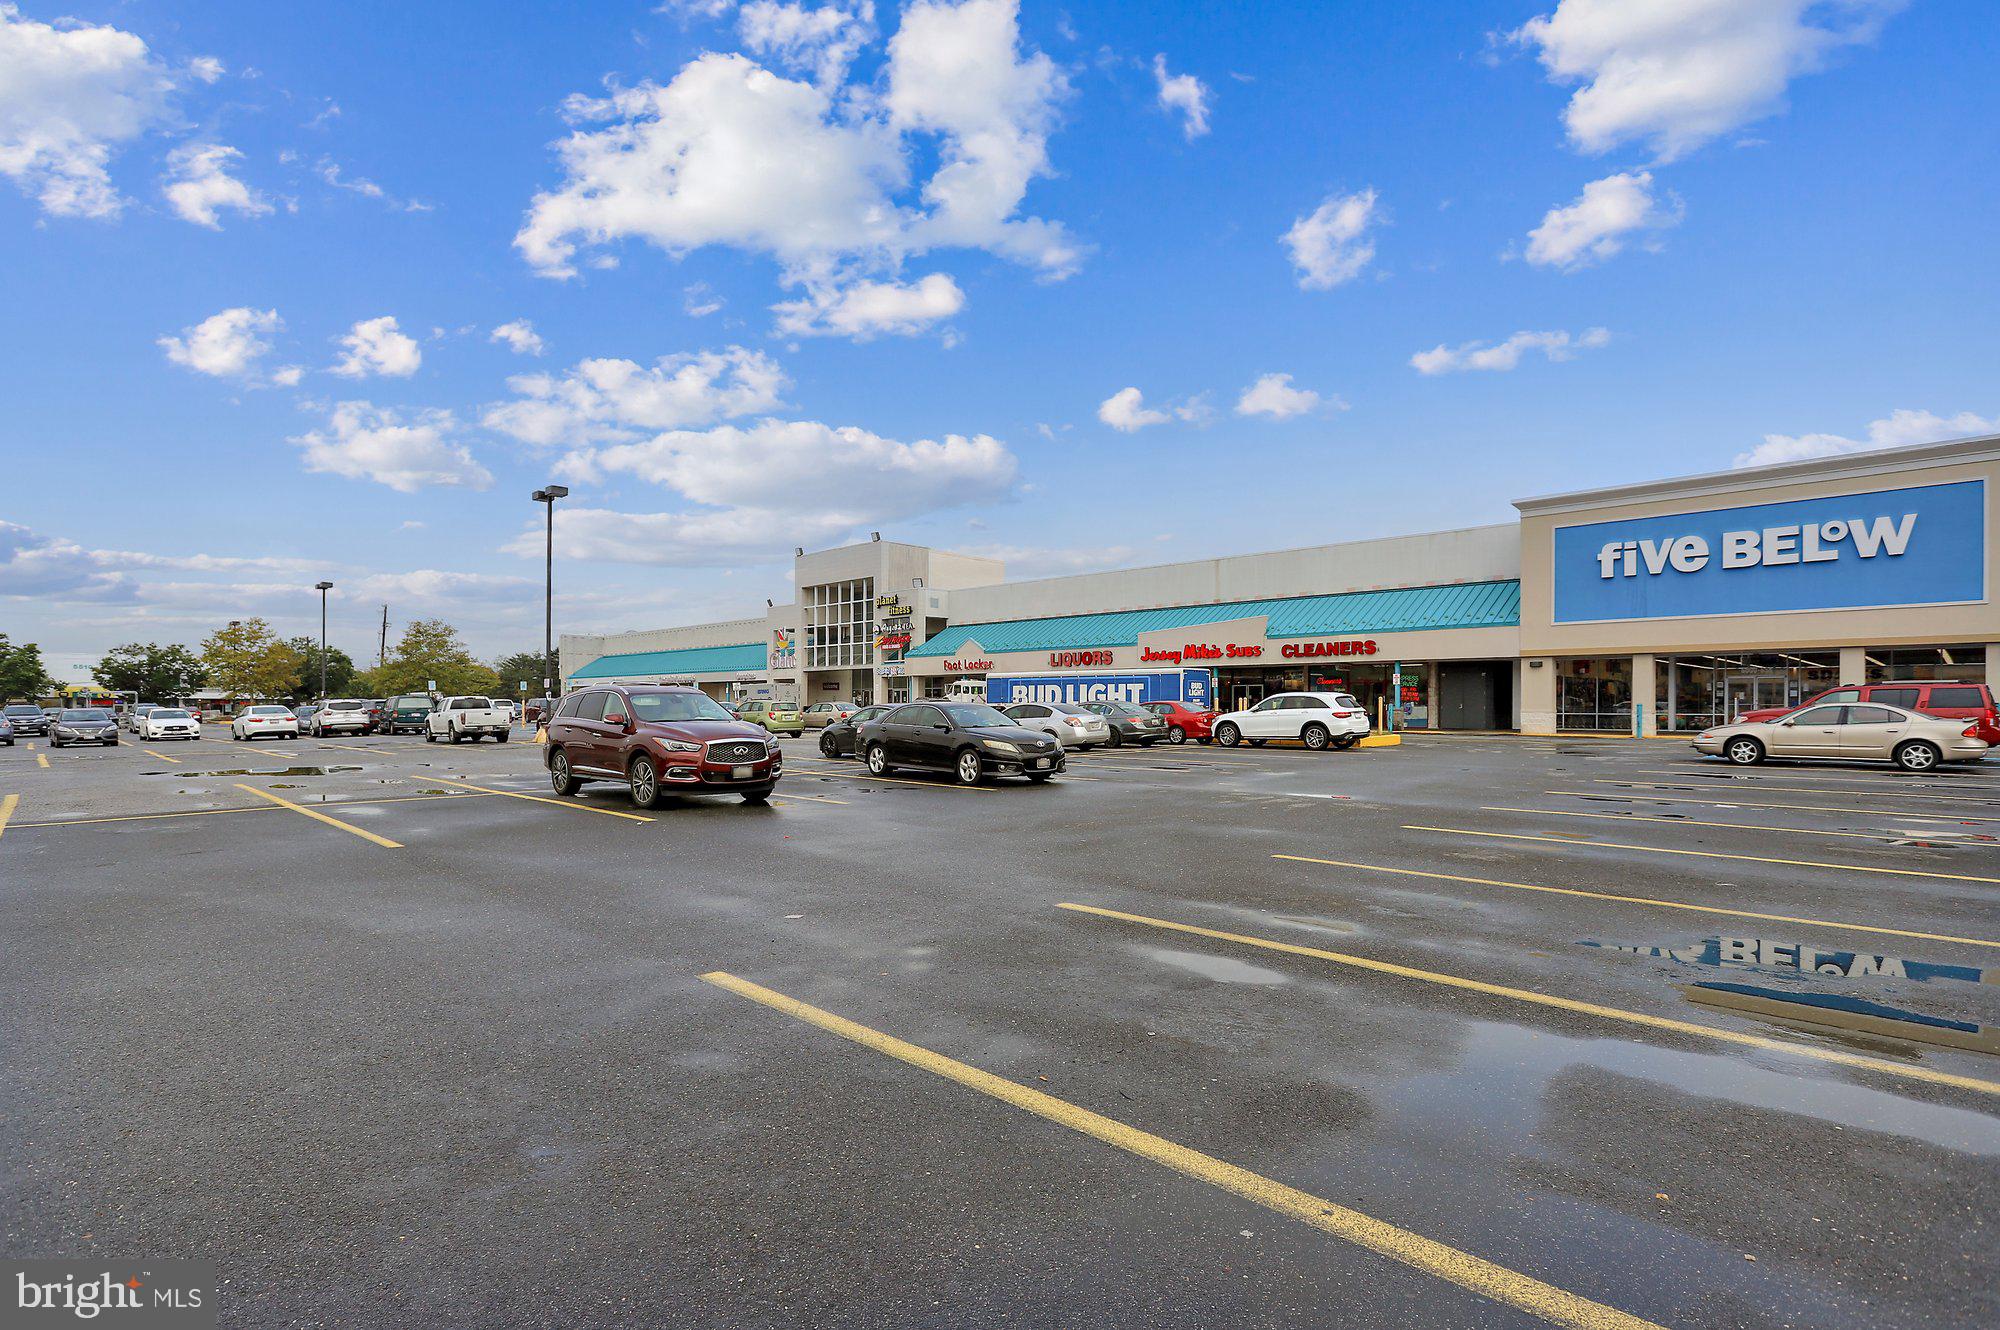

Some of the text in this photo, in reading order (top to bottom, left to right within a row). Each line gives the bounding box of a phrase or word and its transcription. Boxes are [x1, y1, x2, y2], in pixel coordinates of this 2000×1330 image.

[876, 595, 898, 608] planet
[1141, 647, 1181, 664] Jersey
[1183, 644, 1223, 659] Mike's
[1281, 640, 1377, 658] CLEANERS
[770, 651, 796, 668] Giant
[944, 658, 994, 671] Foot Locker
[1050, 651, 1113, 667] LIQUORS
[1012, 684, 1144, 704] BUD LIGHT
[1190, 682, 1203, 690] BUD
